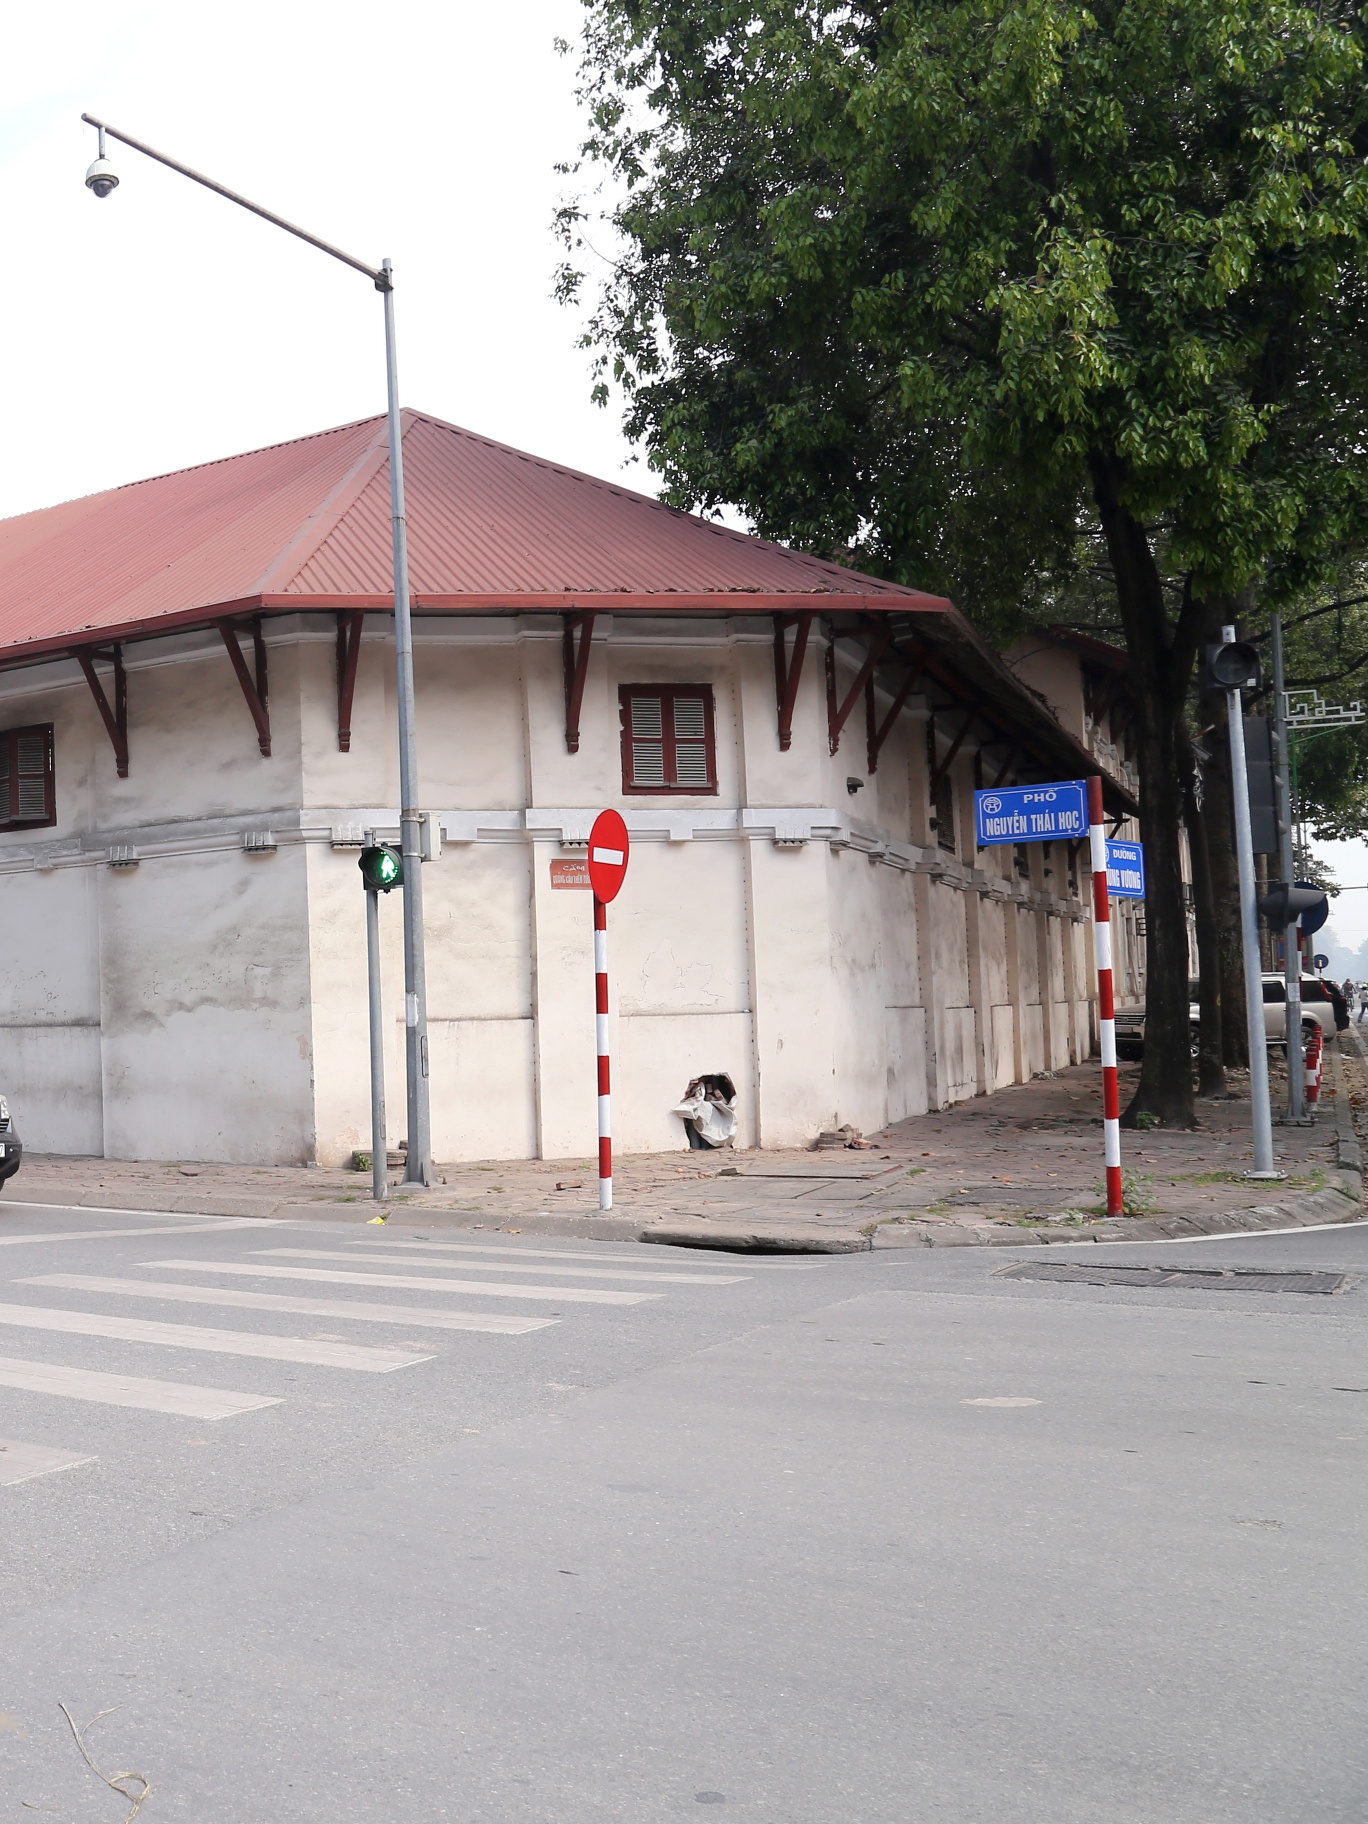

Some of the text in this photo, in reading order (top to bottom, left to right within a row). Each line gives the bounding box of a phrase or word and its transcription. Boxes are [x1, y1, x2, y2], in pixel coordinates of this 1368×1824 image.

[986, 809, 1079, 836] NGUYỄN THÁI HỌC
[1112, 847, 1137, 861] ĐƯỜNG
[1106, 863, 1141, 889] ÙNG VƯƠNG
